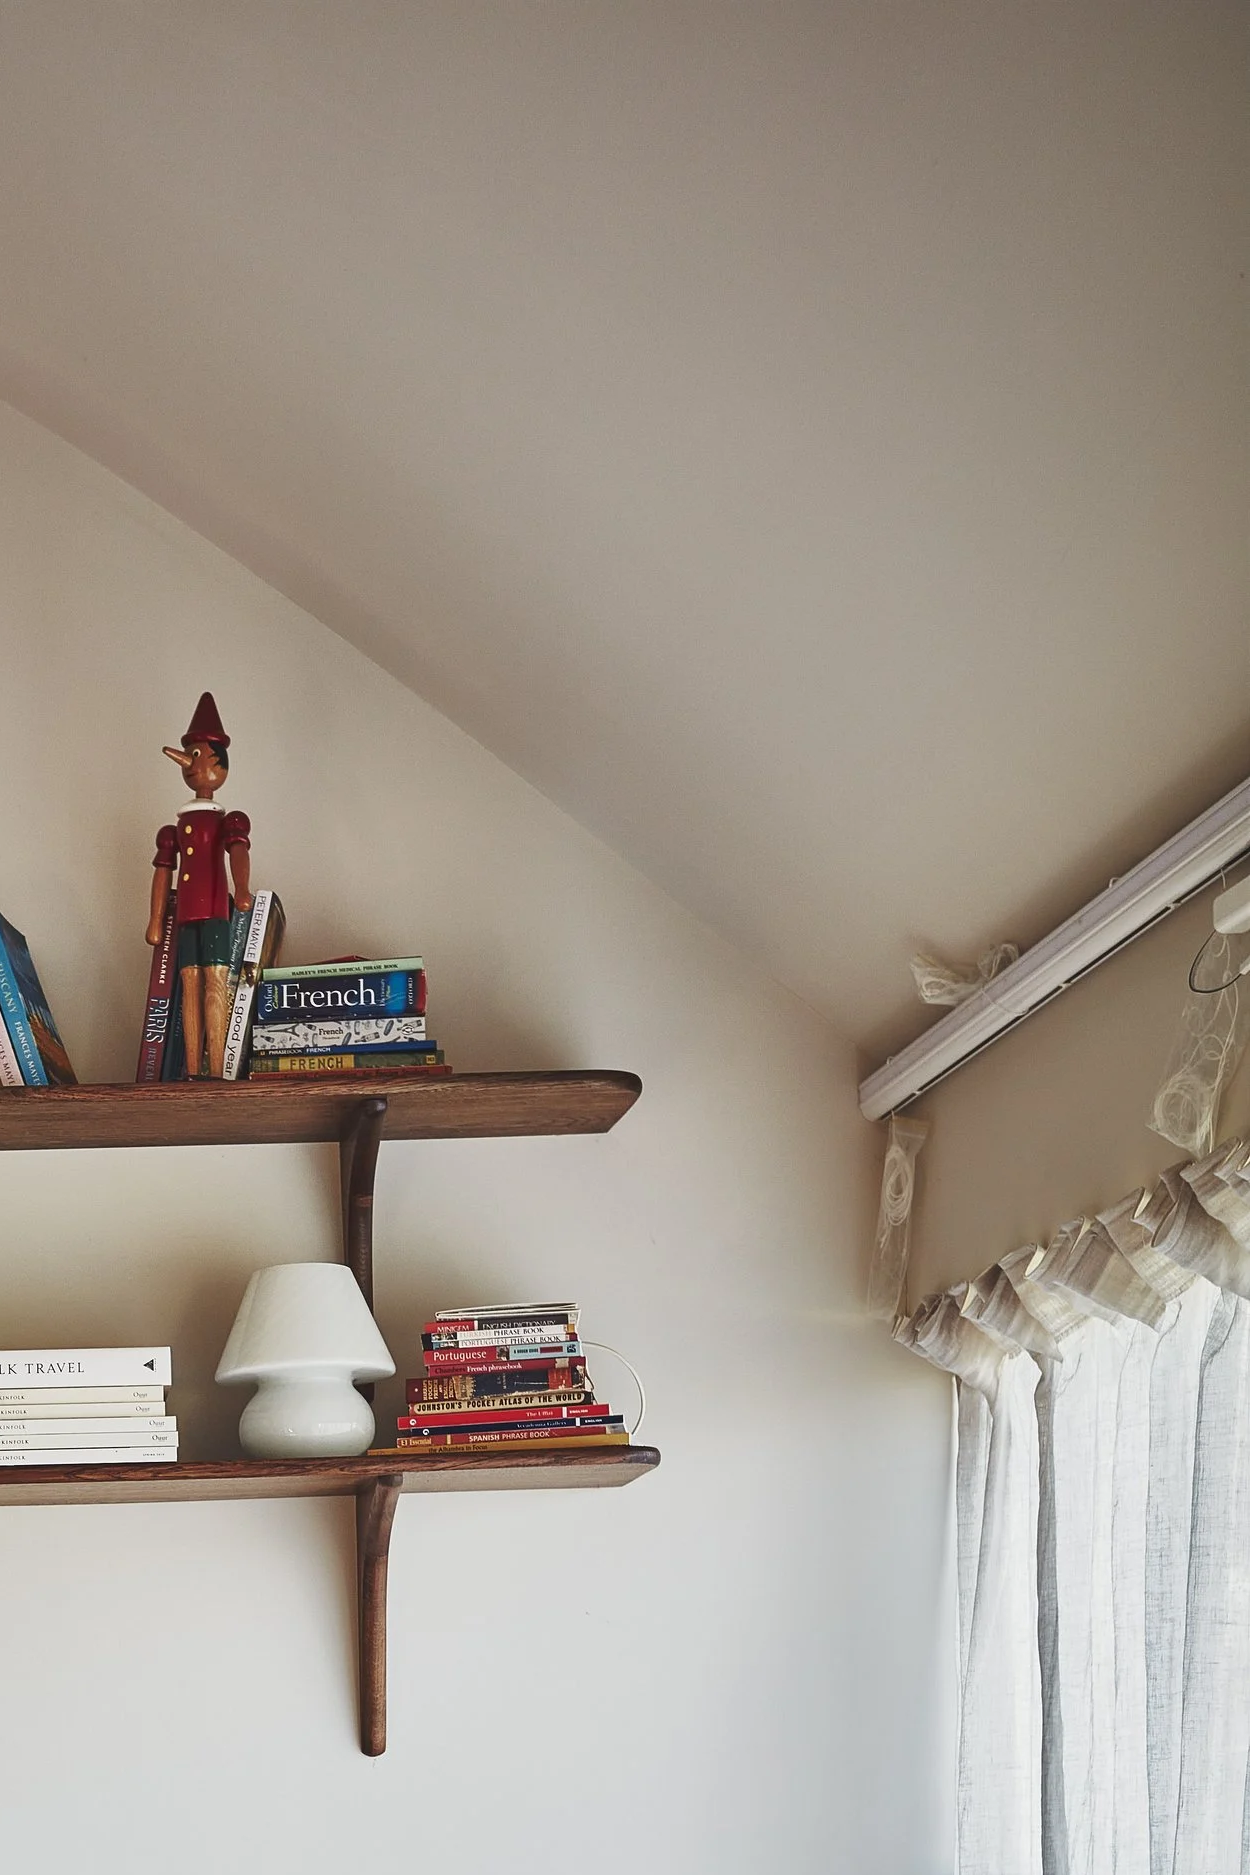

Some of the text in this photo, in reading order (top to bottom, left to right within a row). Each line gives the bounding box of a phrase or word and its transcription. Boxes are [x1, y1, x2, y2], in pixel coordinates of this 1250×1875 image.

[247, 895, 266, 959] PETER MAYLE
[158, 915, 174, 985] STEPHEN CLARKE
[265, 984, 273, 1012] Oxford
[281, 978, 376, 1009] French
[146, 997, 170, 1044] PARIS
[14, 1021, 32, 1059] FRANCES
[225, 993, 247, 1077] a good year
[318, 1027, 343, 1036] French
[290, 1056, 344, 1070] FRENCH
[494, 1329, 520, 1337] PHRASE
[433, 1351, 487, 1362] Portuguese
[24, 1362, 85, 1374] TRAVEL
[488, 1363, 523, 1372] phrasebook
[417, 1402, 462, 1412] JOHNSTON'S
[467, 1399, 495, 1408] POCKET
[499, 1397, 523, 1406] ATLAS
[537, 1395, 552, 1403] THE
[556, 1393, 582, 1402] WORLD
[469, 1434, 500, 1442] SPANISH
[530, 1430, 550, 1438] BOOK
